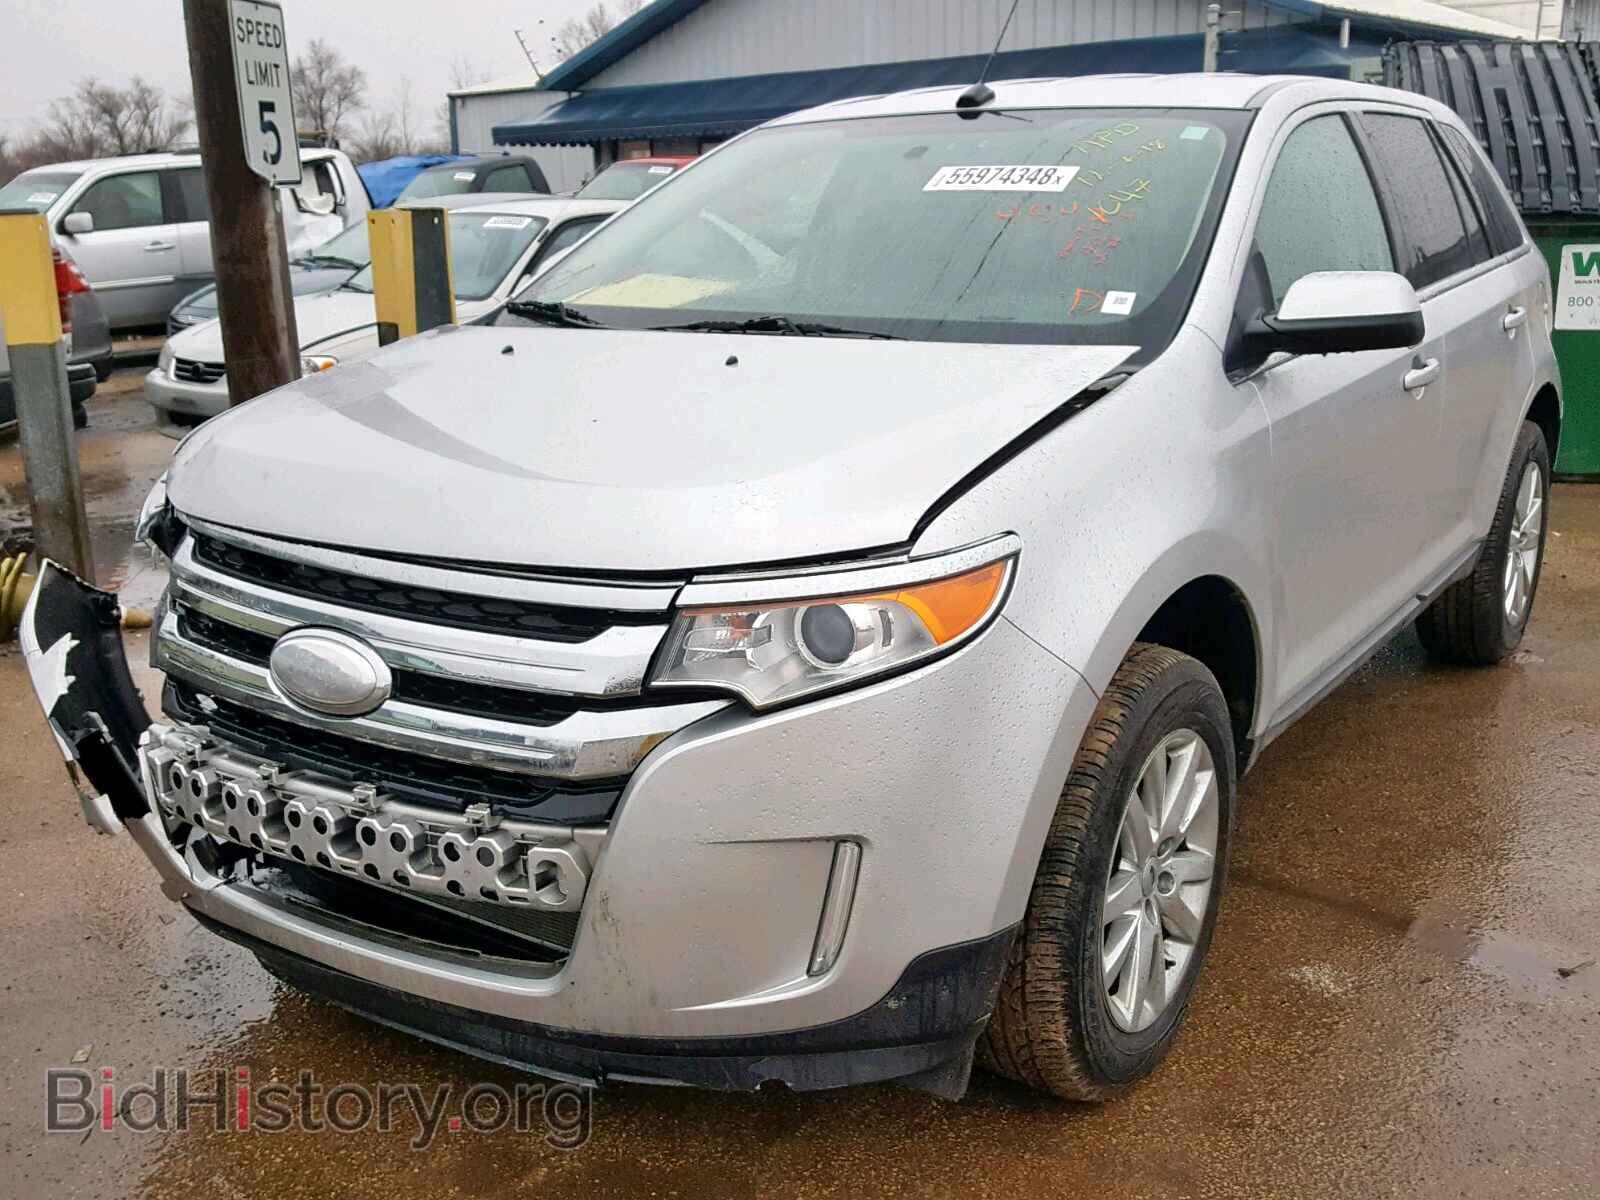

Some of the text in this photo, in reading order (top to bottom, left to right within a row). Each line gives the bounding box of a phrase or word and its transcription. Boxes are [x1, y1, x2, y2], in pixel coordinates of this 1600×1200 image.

[236, 17, 282, 48] SPEED
[245, 60, 281, 88] LIMIT
[258, 101, 282, 165] 5
[1567, 296, 1594, 307] 800
